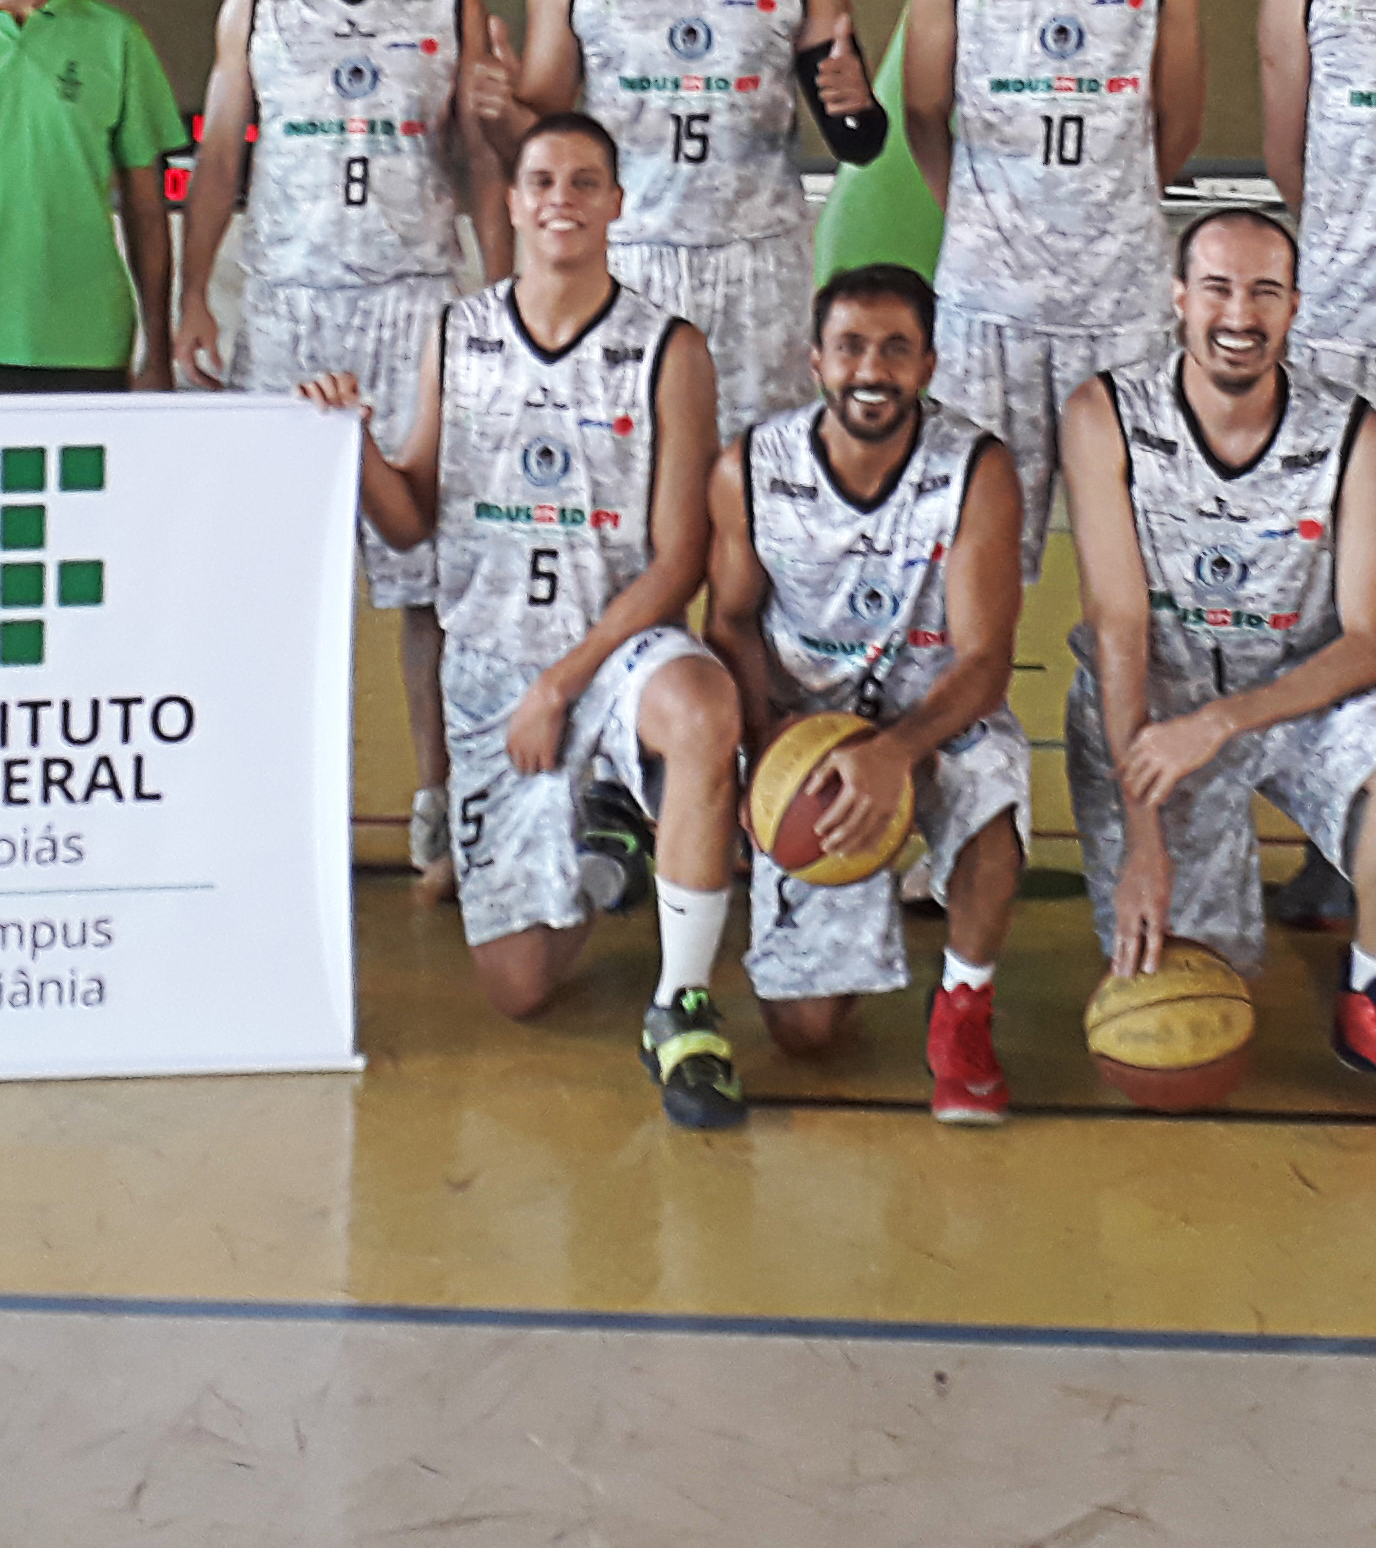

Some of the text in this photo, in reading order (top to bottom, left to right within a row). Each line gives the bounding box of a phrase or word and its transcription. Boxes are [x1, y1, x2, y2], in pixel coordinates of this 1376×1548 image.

[670, 113, 710, 165] 15
[1040, 114, 1084, 166] 10
[345, 156, 368, 206] 8
[527, 547, 559, 606] 5
[460, 789, 491, 848] 5
